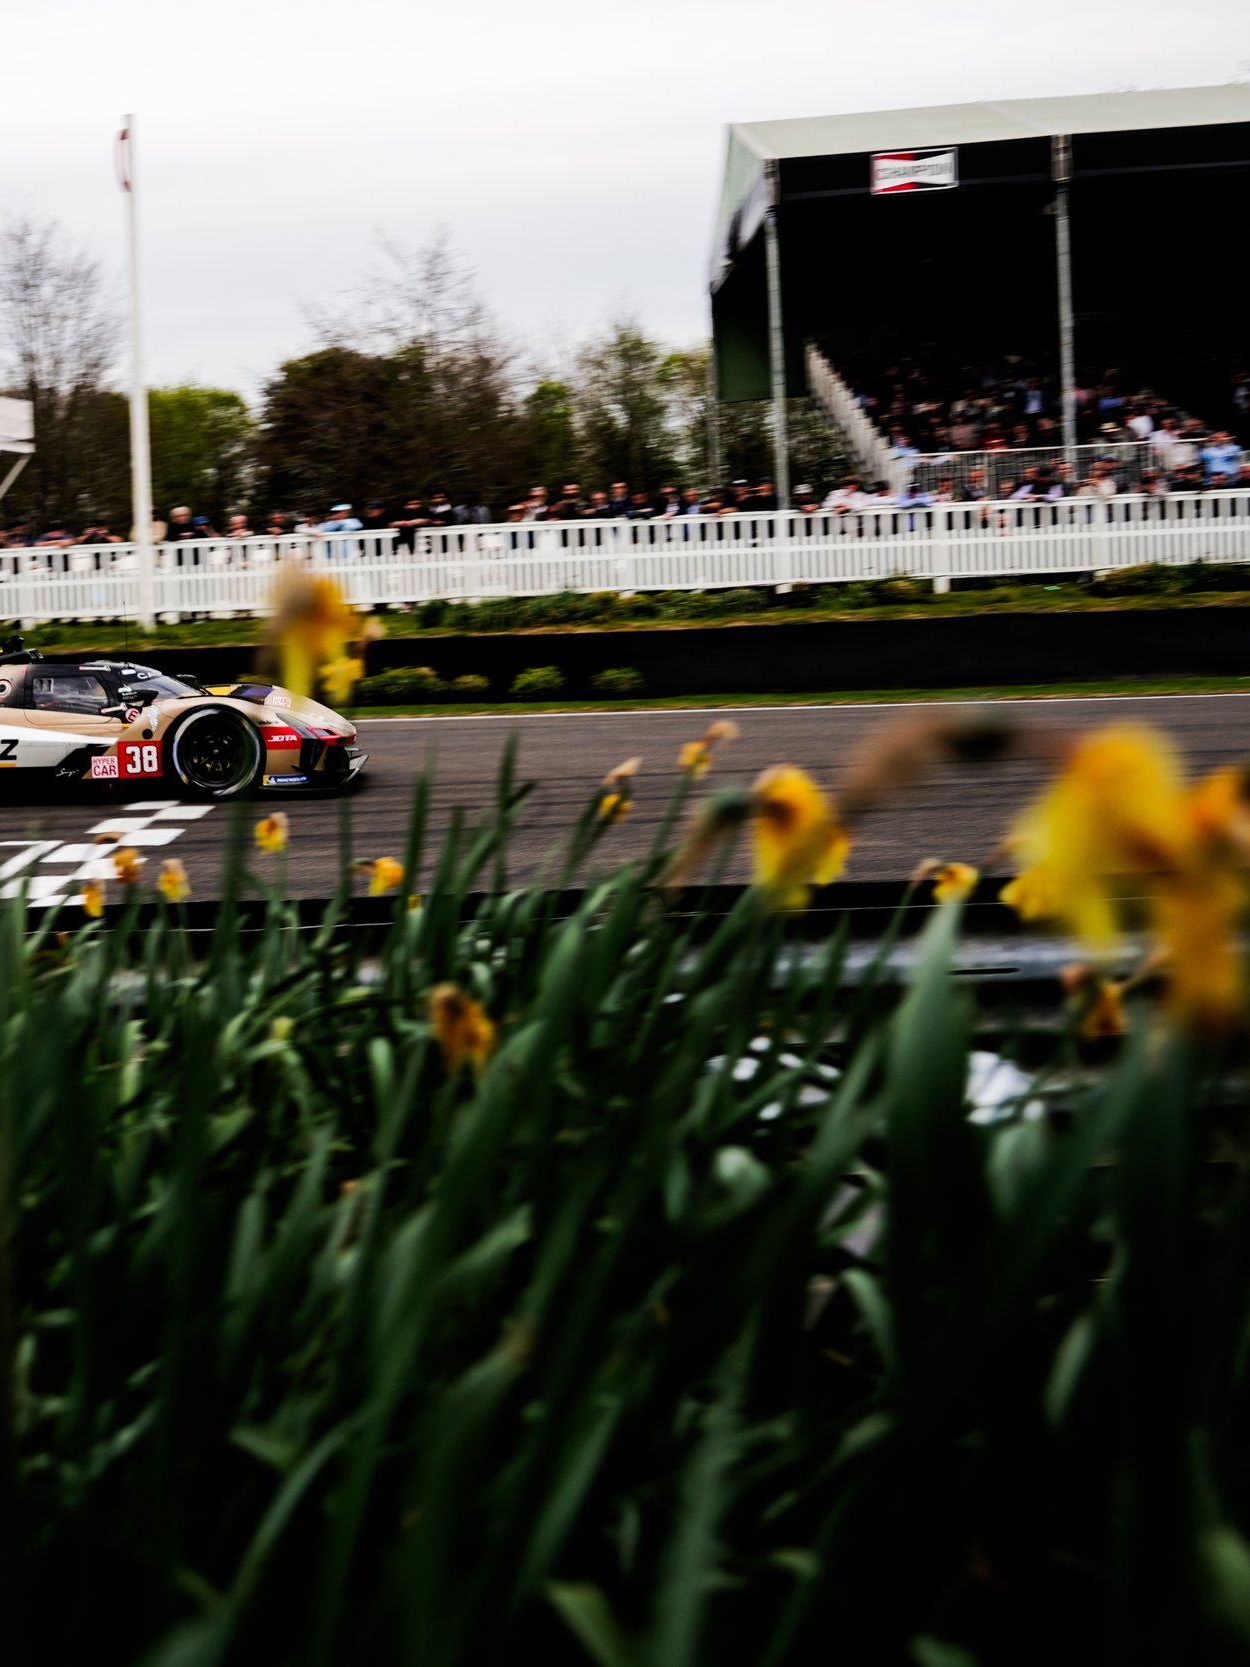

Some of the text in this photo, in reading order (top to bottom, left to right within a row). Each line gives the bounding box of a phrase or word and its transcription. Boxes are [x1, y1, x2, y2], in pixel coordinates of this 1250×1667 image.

[268, 734, 298, 743] JOTA
[92, 757, 116, 765] HYPER
[125, 745, 159, 774] 38
[93, 764, 117, 776] CAR
